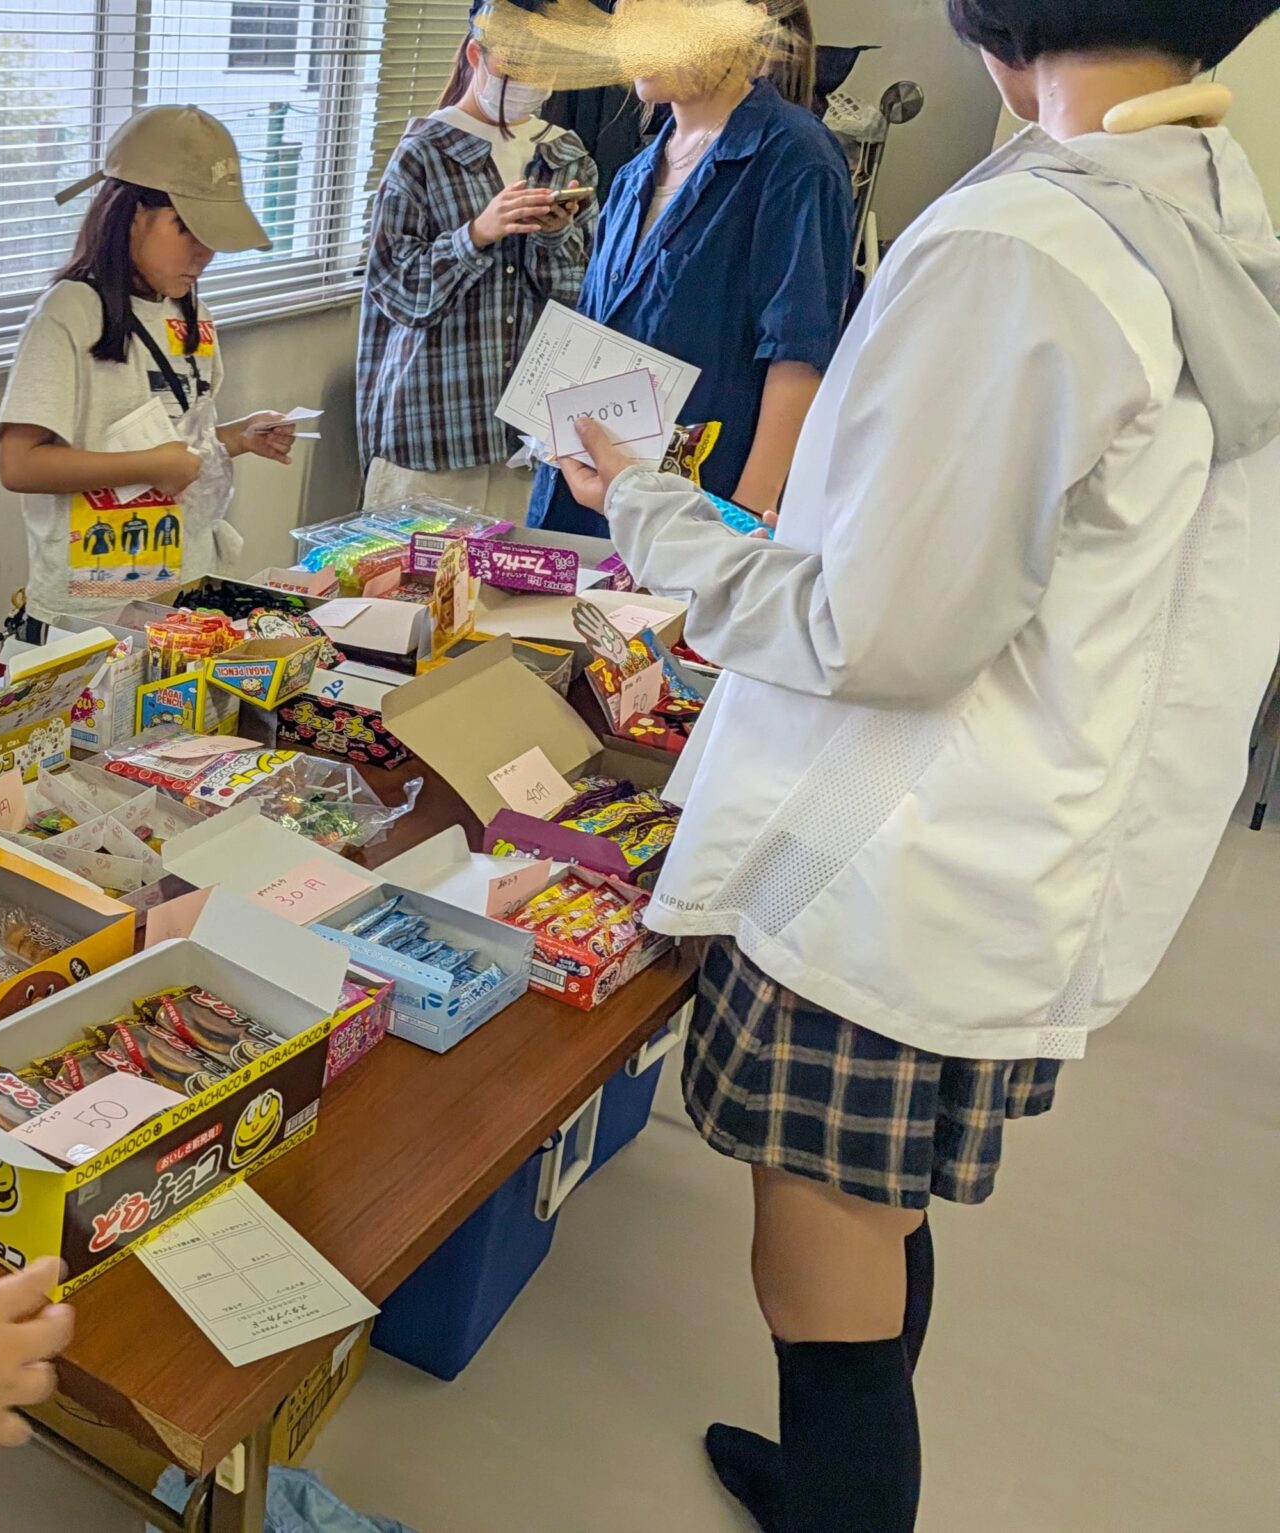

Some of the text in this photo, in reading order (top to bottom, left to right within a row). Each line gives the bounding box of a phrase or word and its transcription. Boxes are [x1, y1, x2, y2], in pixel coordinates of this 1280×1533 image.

[244, 664, 272, 676] YAGAI
[156, 695, 185, 710] PENCIL
[157, 687, 183, 700] YAGAI
[322, 679, 344, 699] 20
[278, 725, 302, 742] Jack
[525, 781, 551, 805] 40円
[274, 877, 327, 906] 30円
[658, 892, 706, 912] KIPRUN
[258, 1026, 323, 1073] DORACHOCO
[172, 1074, 241, 1127] DORACHOCO
[73, 1099, 130, 1131] 50
[75, 1127, 152, 1186] DORACHOCO
[243, 1130, 307, 1179] DORACHOCO
[88, 1144, 224, 1254] どらチョコ
[61, 1241, 140, 1298] DORACHOCO
[253, 1302, 308, 1330] スタンプカード
